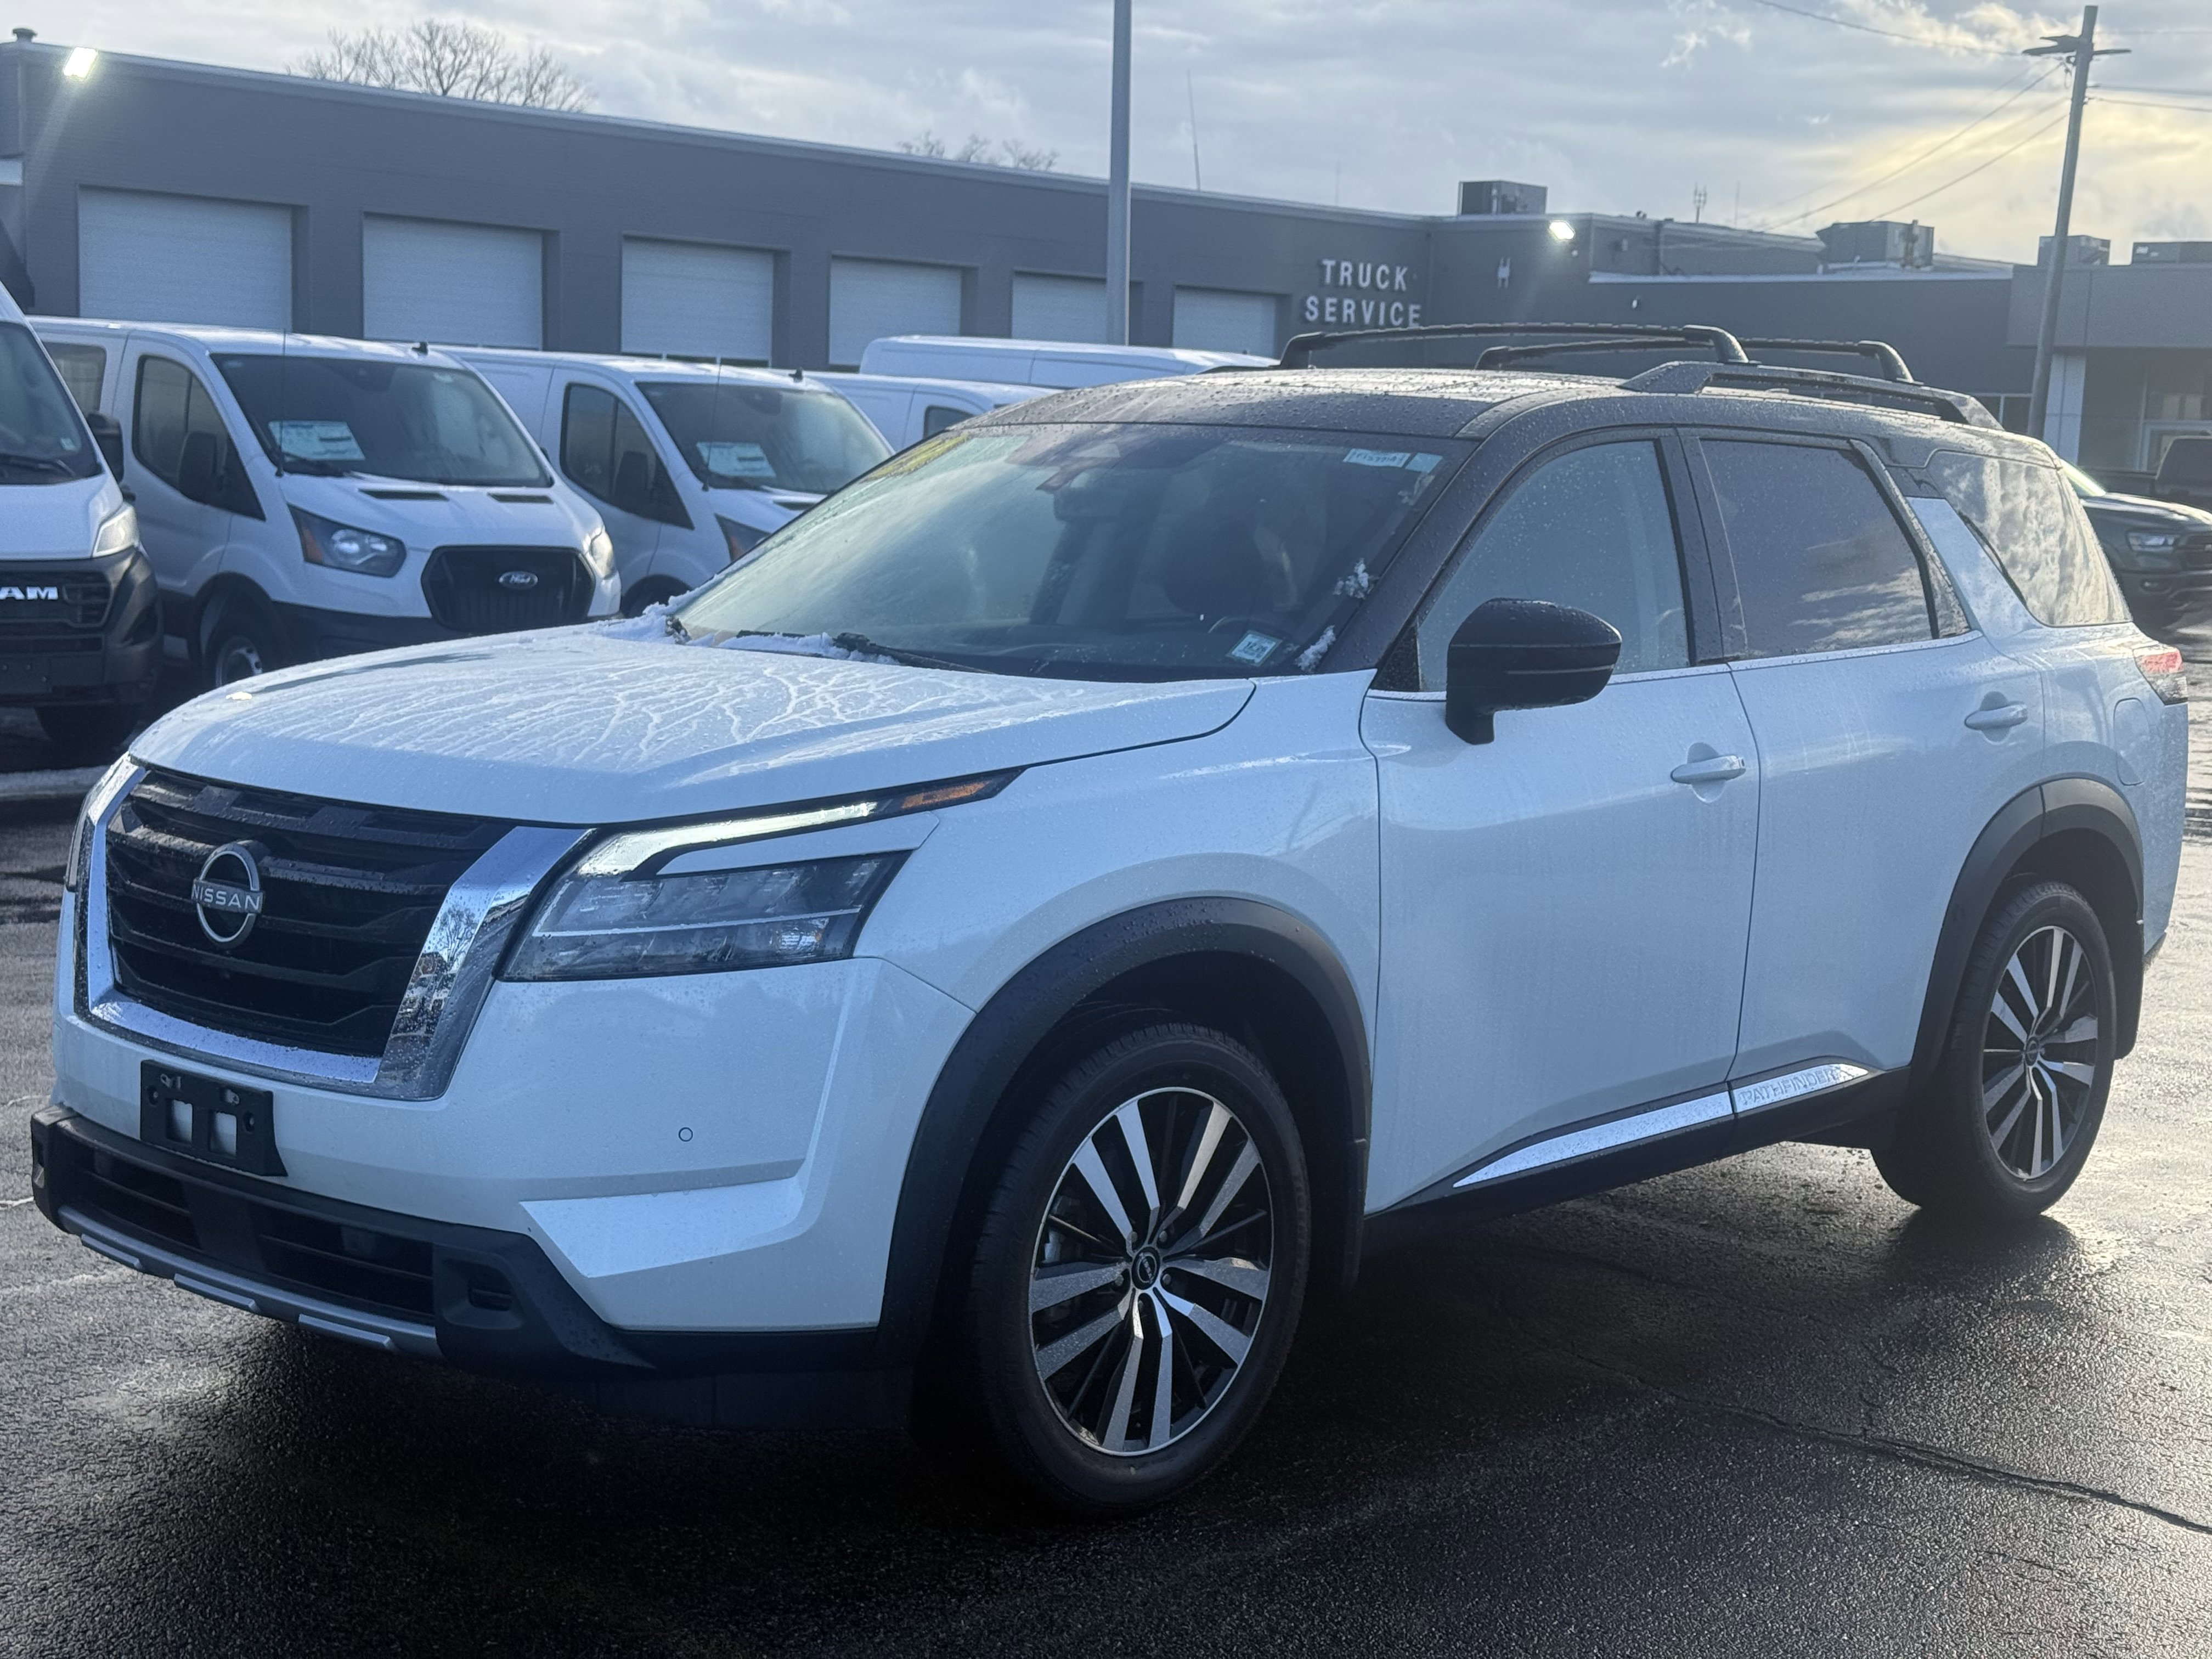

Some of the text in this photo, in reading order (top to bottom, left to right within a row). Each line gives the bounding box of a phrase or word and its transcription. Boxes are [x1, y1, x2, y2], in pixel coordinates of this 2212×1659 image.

[1322, 259, 1408, 291] TRUCK
[1305, 296, 1421, 328] SERVICE
[191, 884, 260, 910] NISSAN
[1740, 1067, 1840, 1105] PATHFINDER
